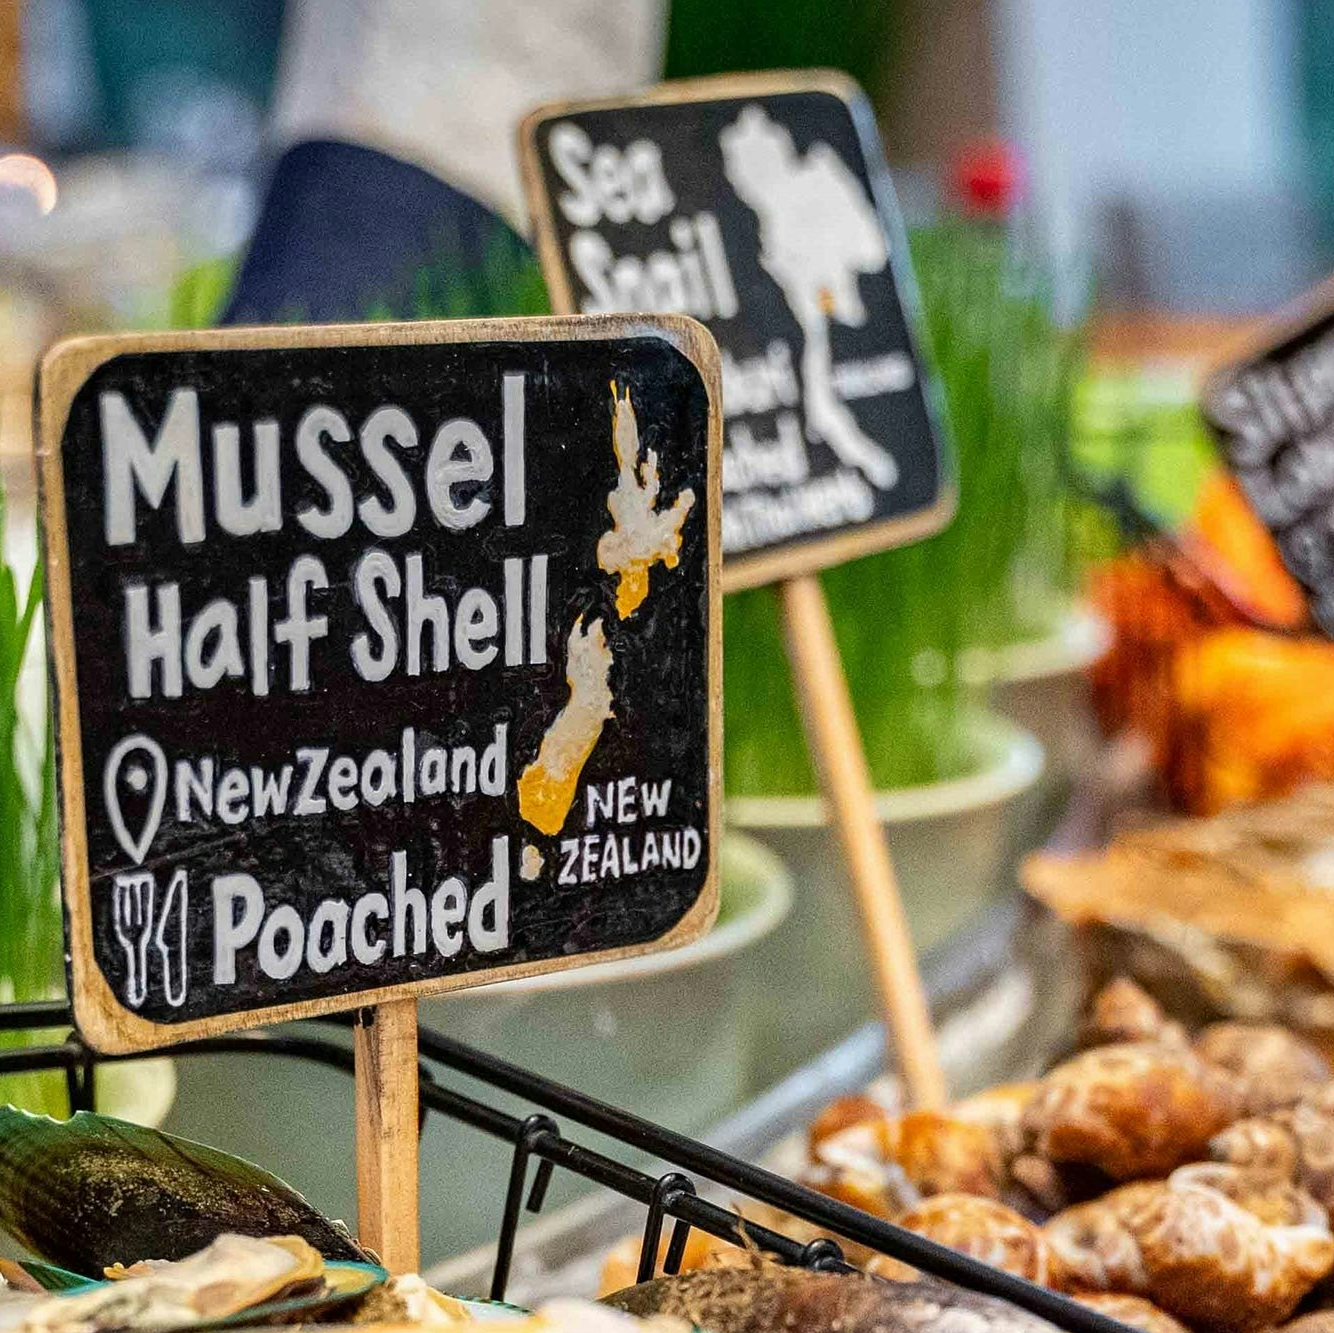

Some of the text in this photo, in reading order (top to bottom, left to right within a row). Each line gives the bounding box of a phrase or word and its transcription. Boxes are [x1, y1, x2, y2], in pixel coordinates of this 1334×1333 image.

[549, 121, 675, 227] Sea
[100, 373, 527, 545] Mussel
[125, 553, 548, 698] Half Shell
[558, 830, 701, 885] ZEALAND
[586, 780, 672, 826] NEW
[213, 835, 510, 984] Poached
